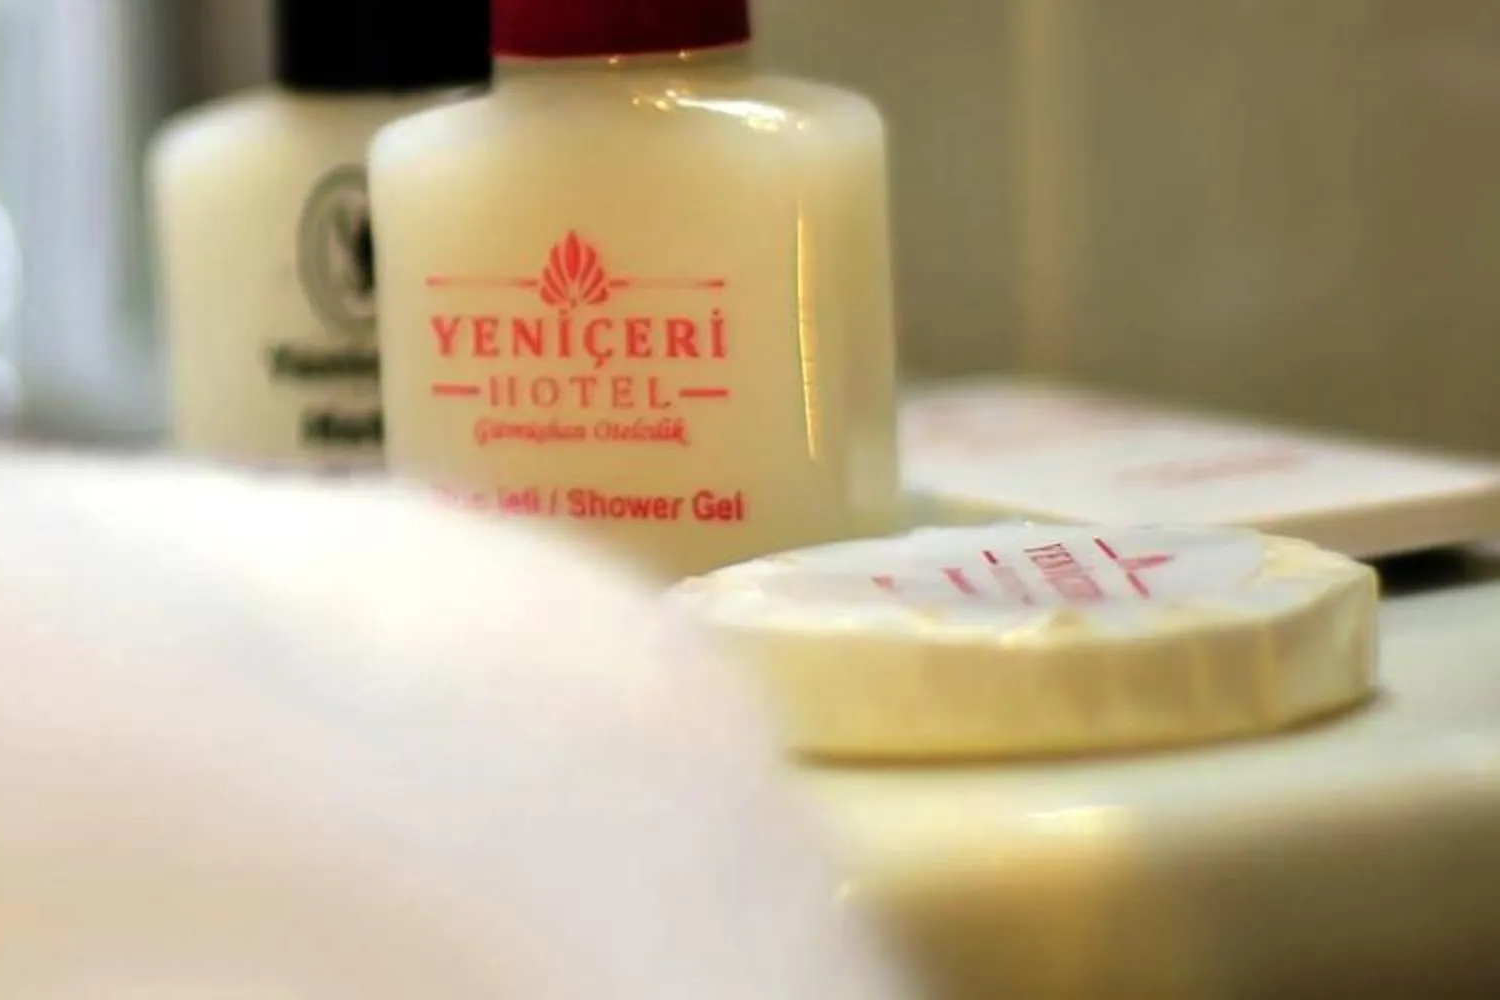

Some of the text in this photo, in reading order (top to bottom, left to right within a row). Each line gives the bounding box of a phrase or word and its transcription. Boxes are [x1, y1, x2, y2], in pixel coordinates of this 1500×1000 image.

[430, 308, 728, 369] YENİÇERİ
[488, 375, 672, 408] HOTEL
[566, 487, 684, 520] Shower
[692, 489, 744, 522] Gel
